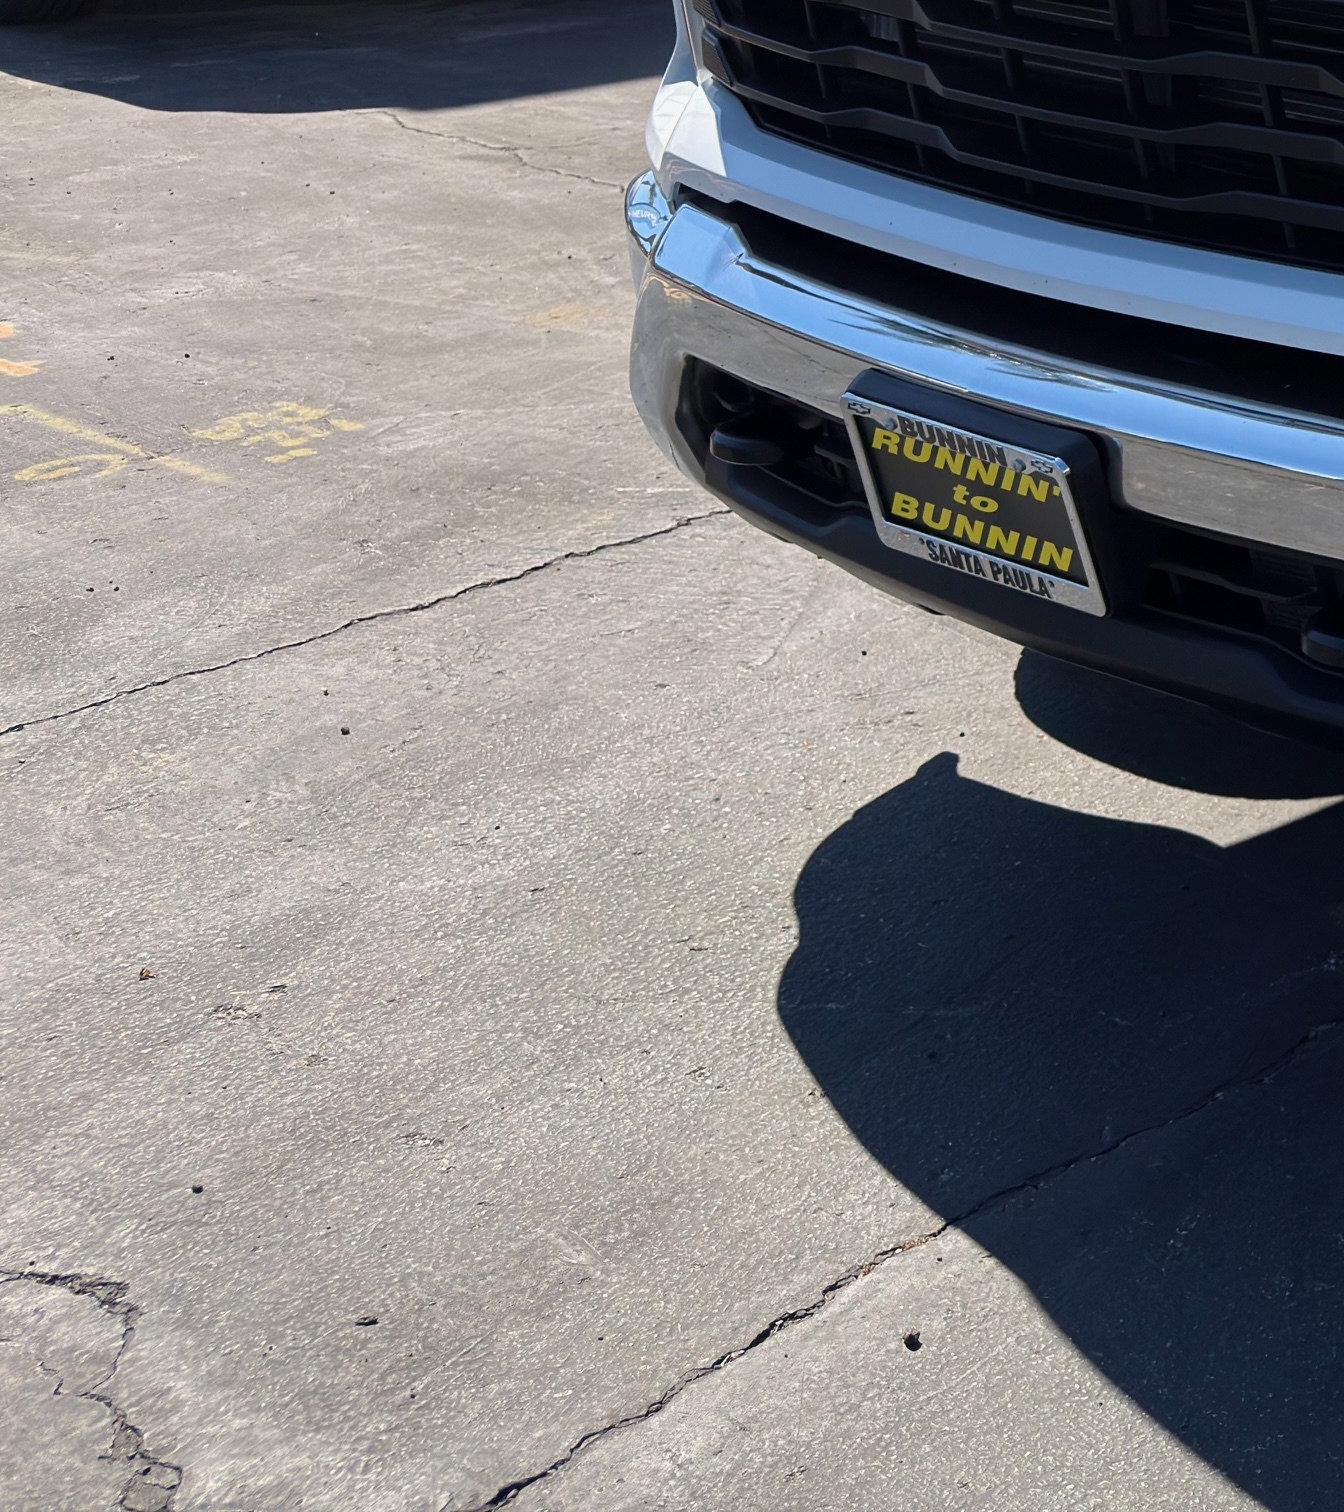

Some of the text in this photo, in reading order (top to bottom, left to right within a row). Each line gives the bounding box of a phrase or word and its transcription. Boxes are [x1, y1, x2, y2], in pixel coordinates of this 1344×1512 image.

[899, 415, 1008, 467] BUNNIN
[953, 484, 999, 513] to
[890, 491, 1074, 572] BUNNIN
